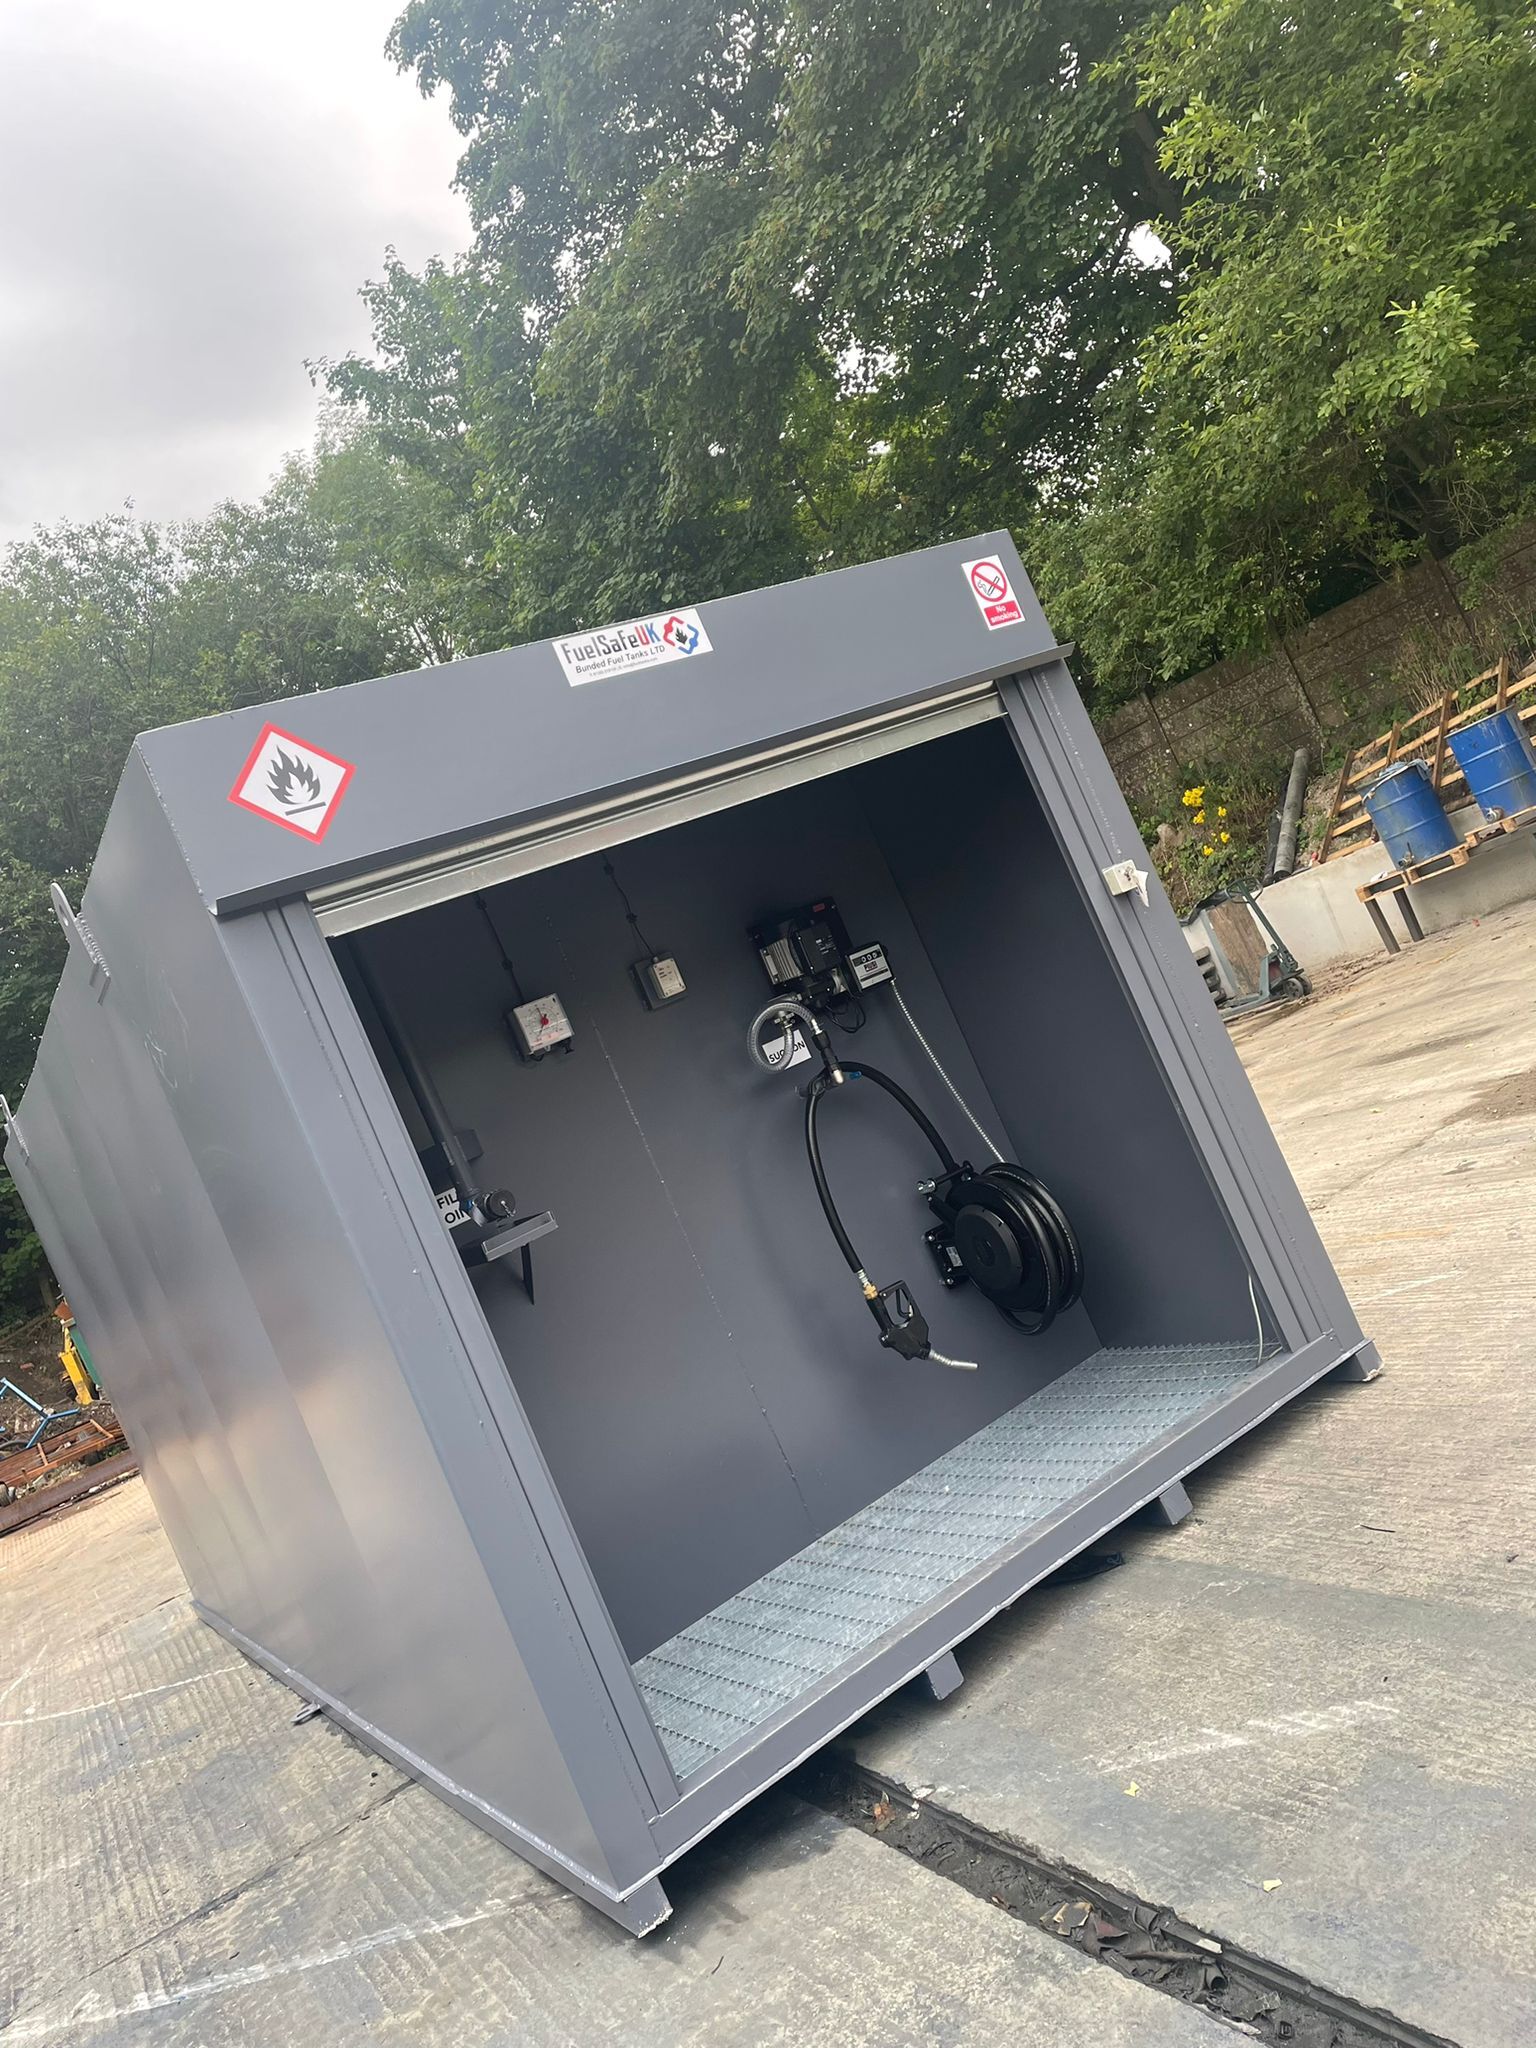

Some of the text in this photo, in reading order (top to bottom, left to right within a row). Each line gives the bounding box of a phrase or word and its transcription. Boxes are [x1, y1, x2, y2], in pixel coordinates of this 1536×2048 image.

[575, 659, 606, 674] Bunded
[607, 654, 625, 666] Fuel
[626, 650, 649, 662] Tanks
[650, 645, 666, 656] LTD
[769, 1040, 806, 1062] SUCON
[437, 1194, 459, 1209] FIL
